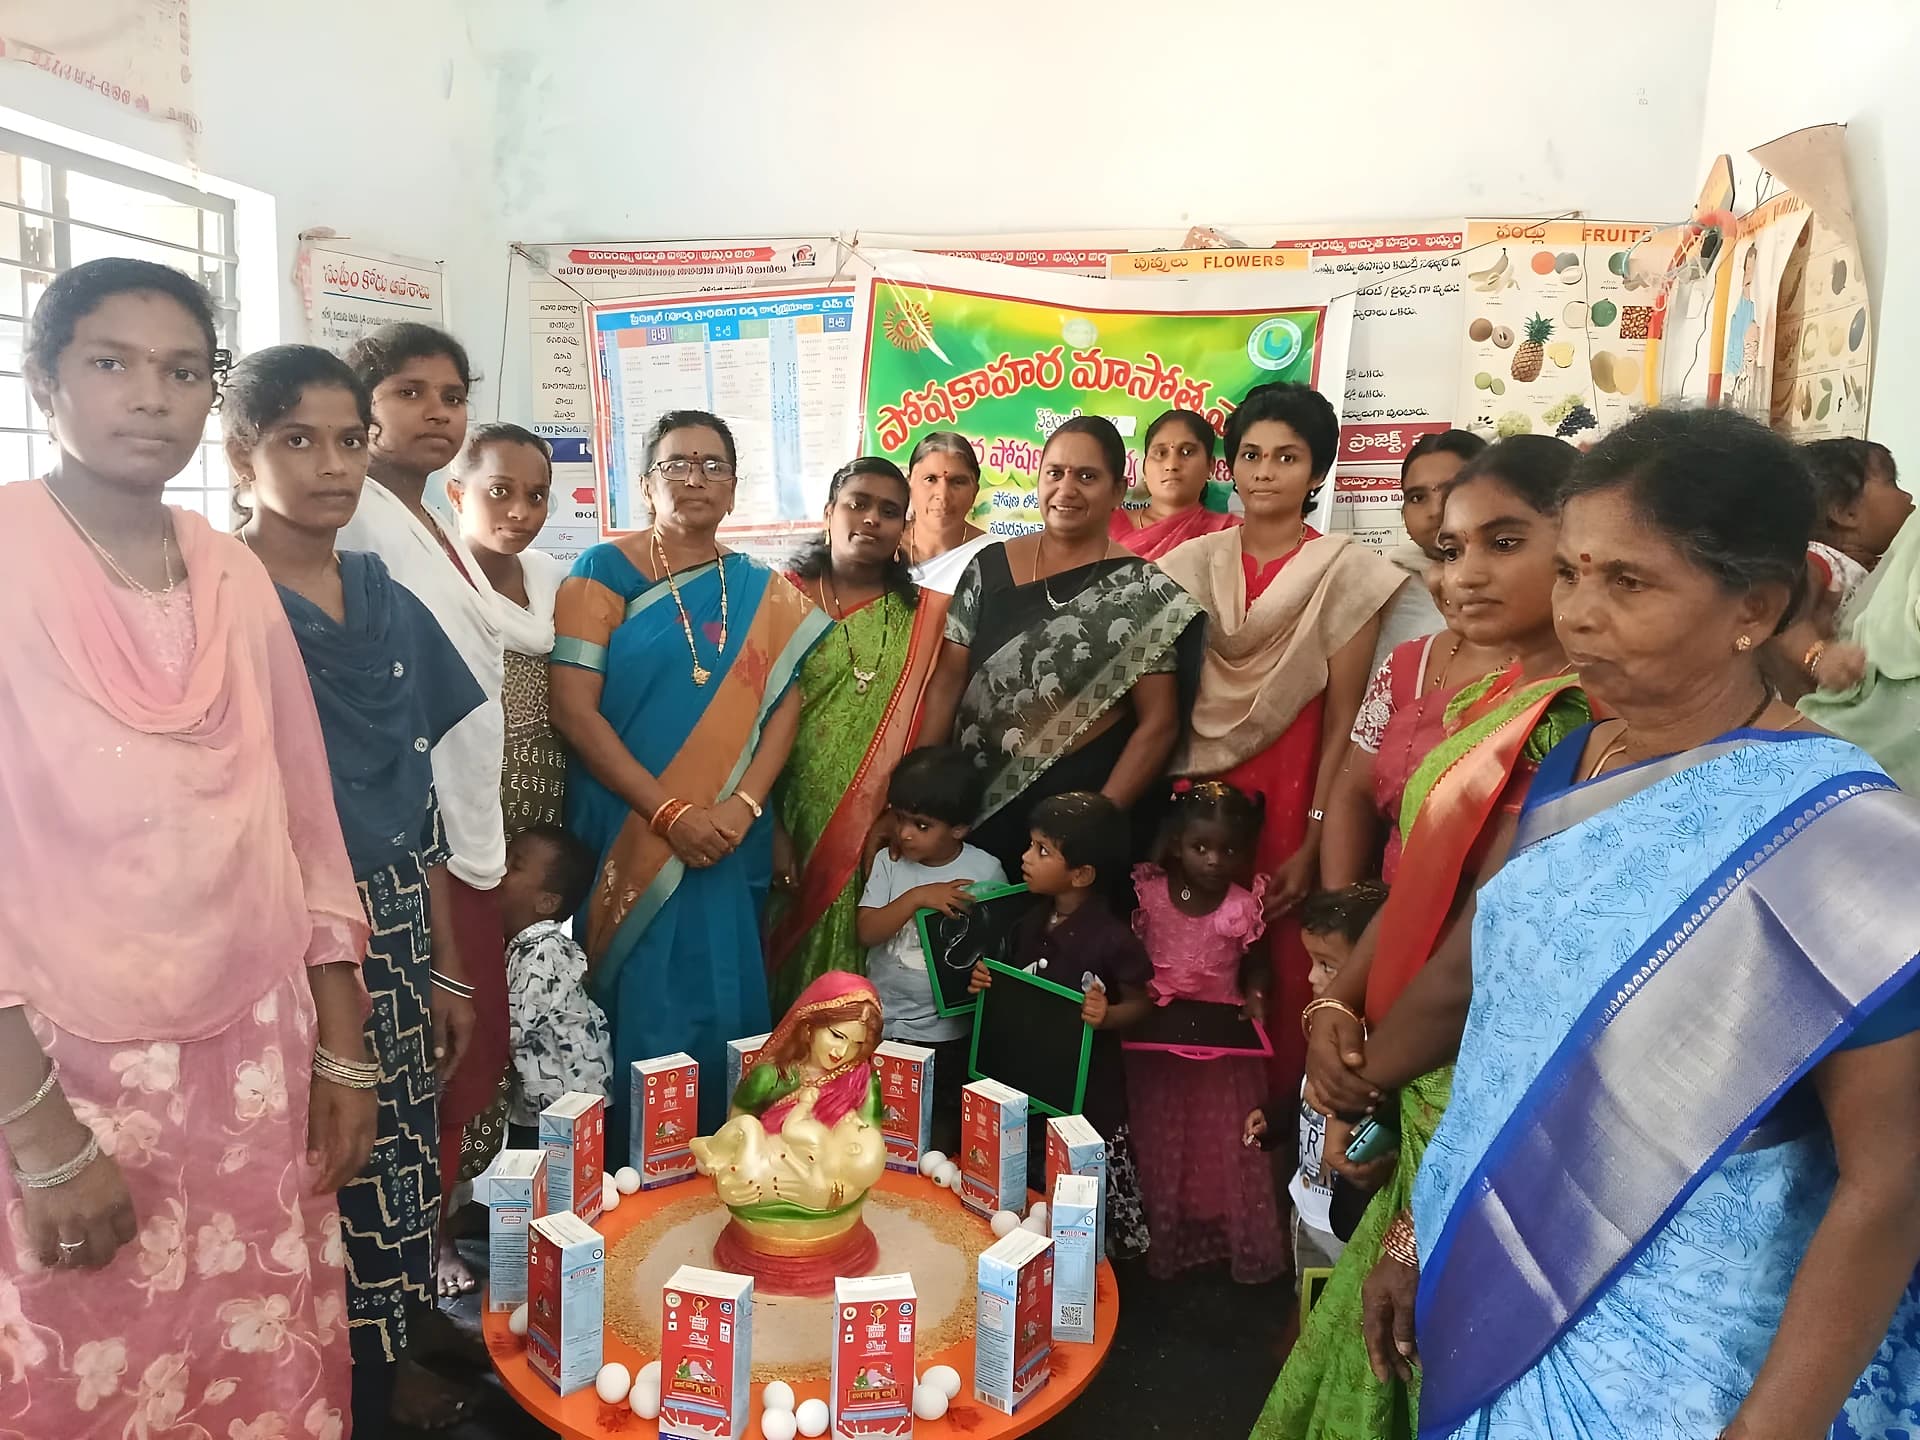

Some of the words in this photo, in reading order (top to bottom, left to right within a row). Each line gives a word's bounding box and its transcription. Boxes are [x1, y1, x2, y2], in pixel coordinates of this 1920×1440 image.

[1581, 228, 1652, 243] FRUITS
[1203, 255, 1285, 269] FLOWERS
[876, 345, 1064, 451] పోషకాహార
